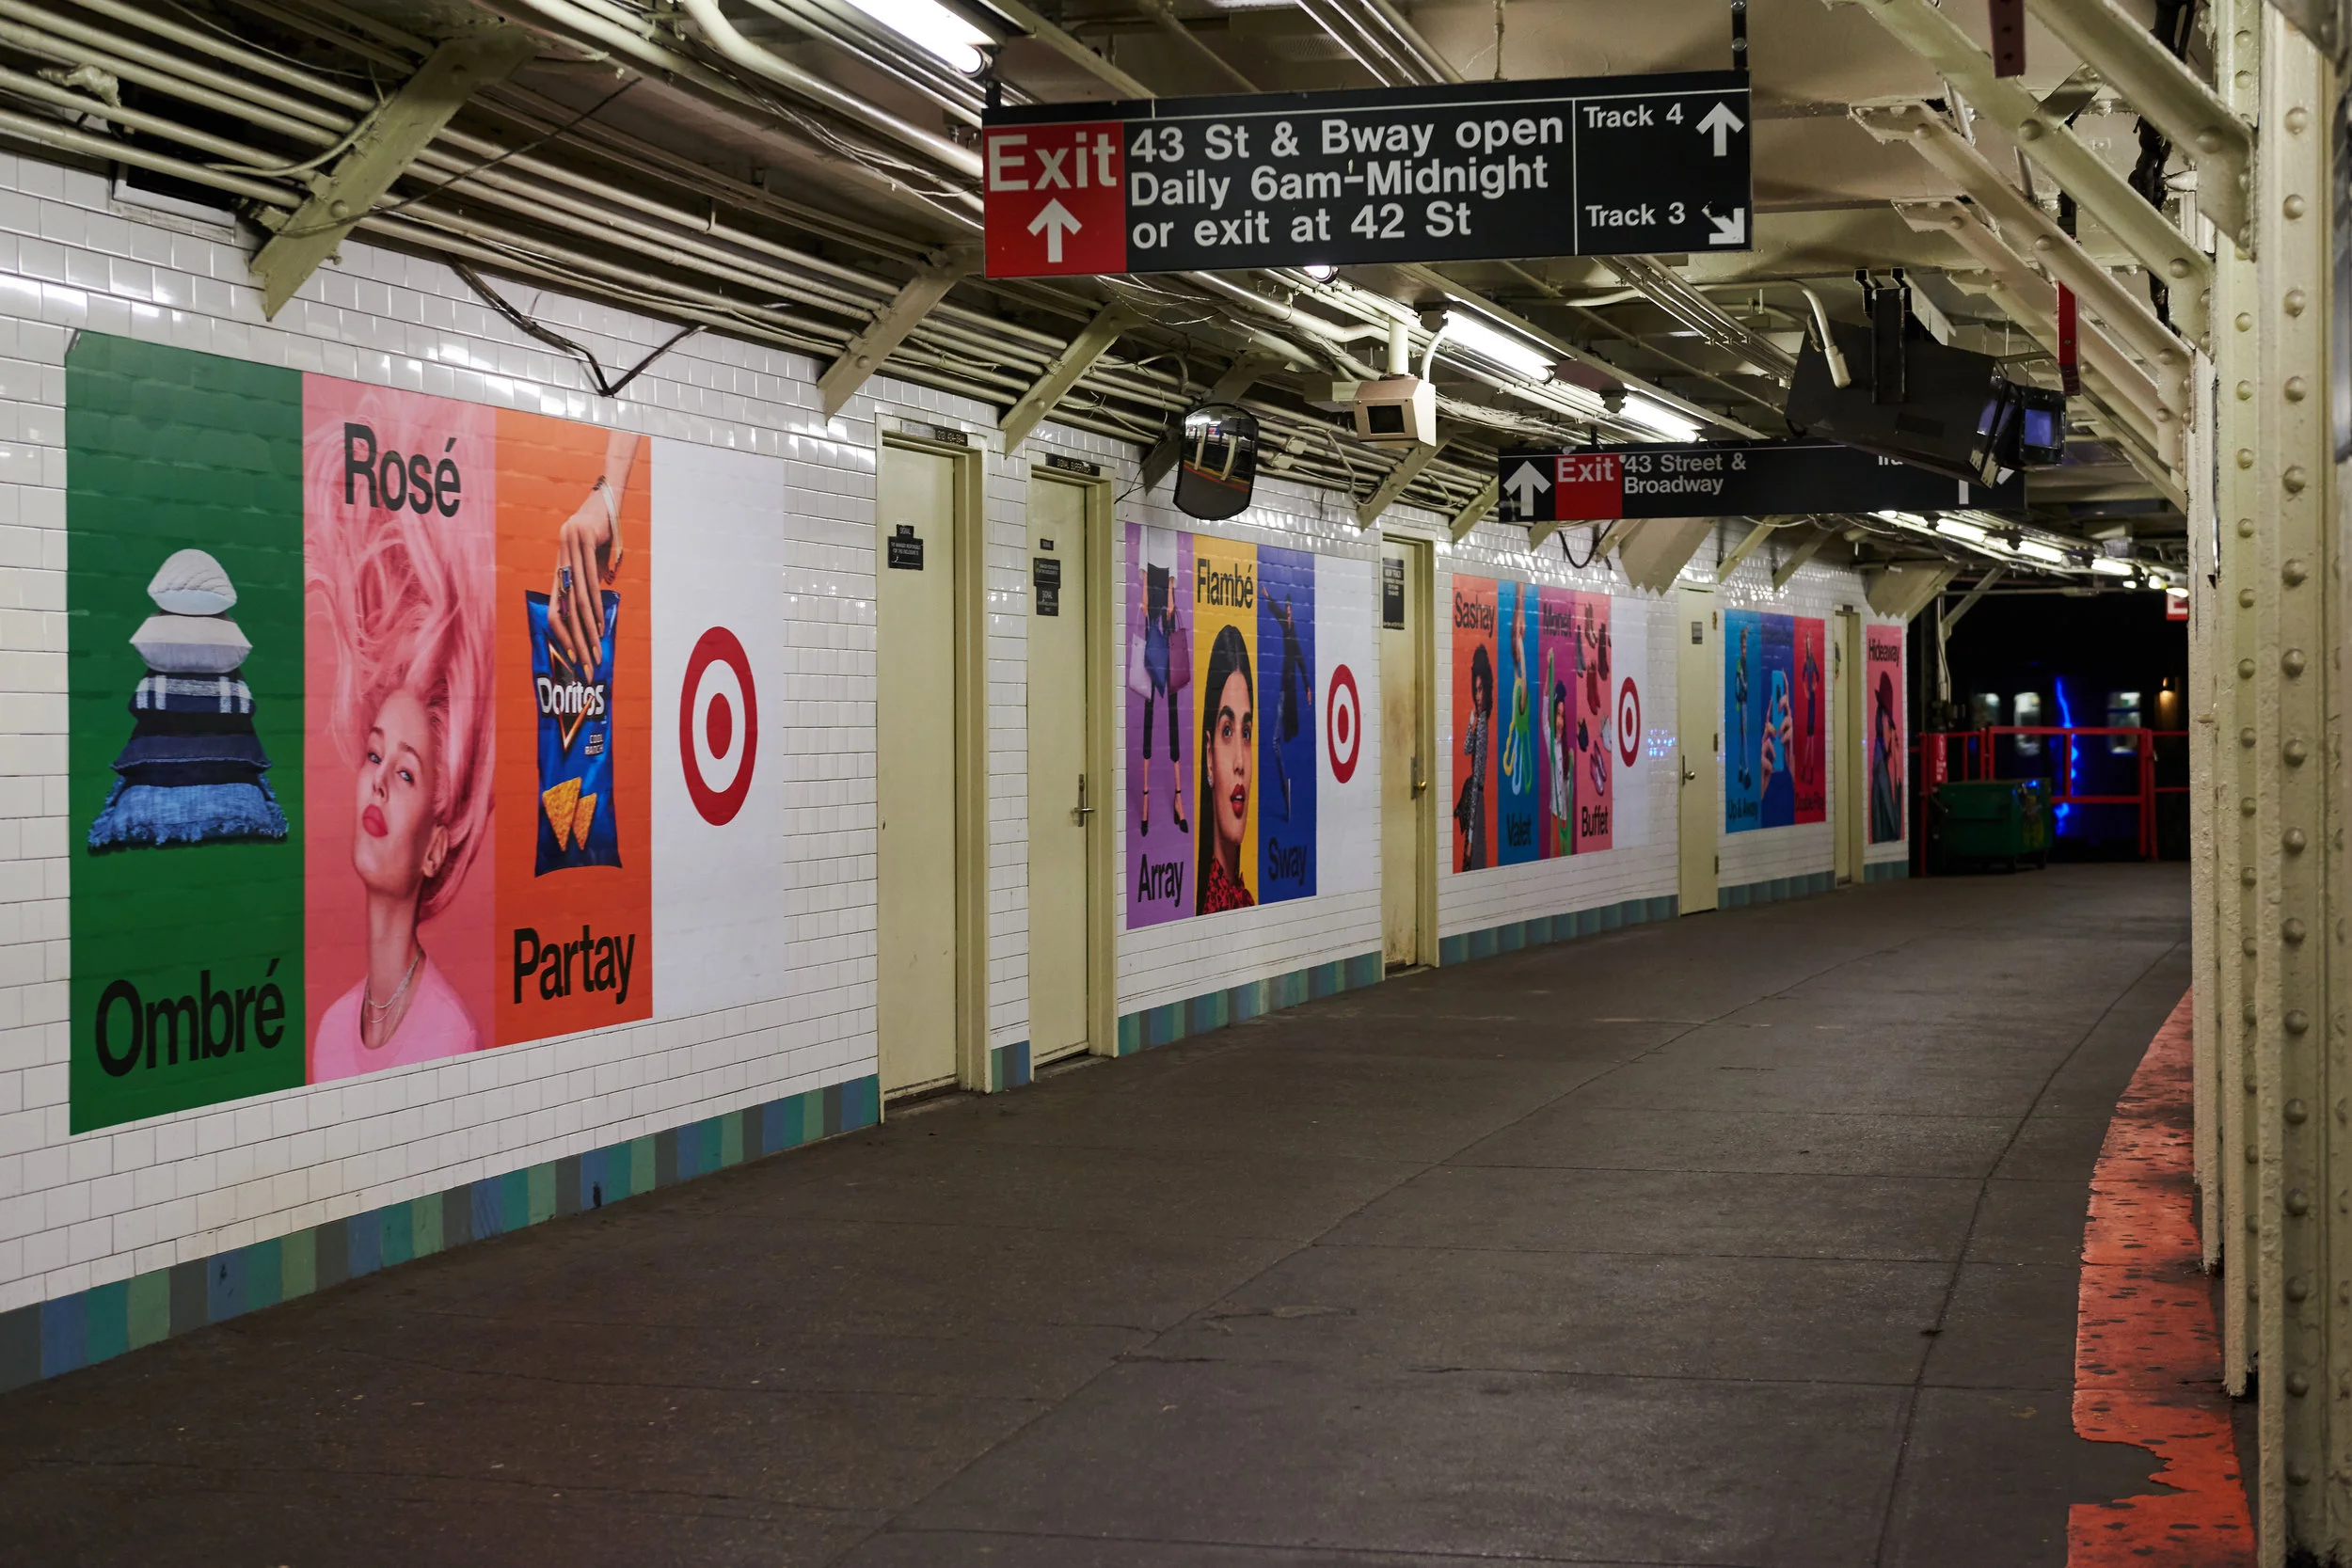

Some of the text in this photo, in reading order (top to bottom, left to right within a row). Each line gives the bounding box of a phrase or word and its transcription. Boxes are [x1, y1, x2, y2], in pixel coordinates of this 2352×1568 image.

[1583, 103, 1684, 130] Track 4
[988, 112, 1565, 193] Exit 43 St & Bway open
[1131, 154, 1549, 213] Daily 6am-Midnight
[1132, 201, 1473, 250] or exit at 42 St
[1585, 202, 1687, 228] Track 3
[343, 422, 462, 519] Rosé
[1557, 456, 1615, 483] Exit
[1624, 452, 1747, 474] 43 Street &
[1624, 474, 1725, 497] Broadway
[1197, 558, 1254, 610] Flambé
[1454, 592, 1496, 639] Sashay
[1868, 639, 1900, 668] Hideaway
[536, 676, 606, 716] Doritos
[1506, 812, 1533, 847] Valet
[1581, 805, 1609, 837] Buffet
[1137, 853, 1184, 909] Array
[1268, 837, 1308, 886] Sway
[513, 923, 636, 1006] Partay
[95, 958, 286, 1078] Ombré
